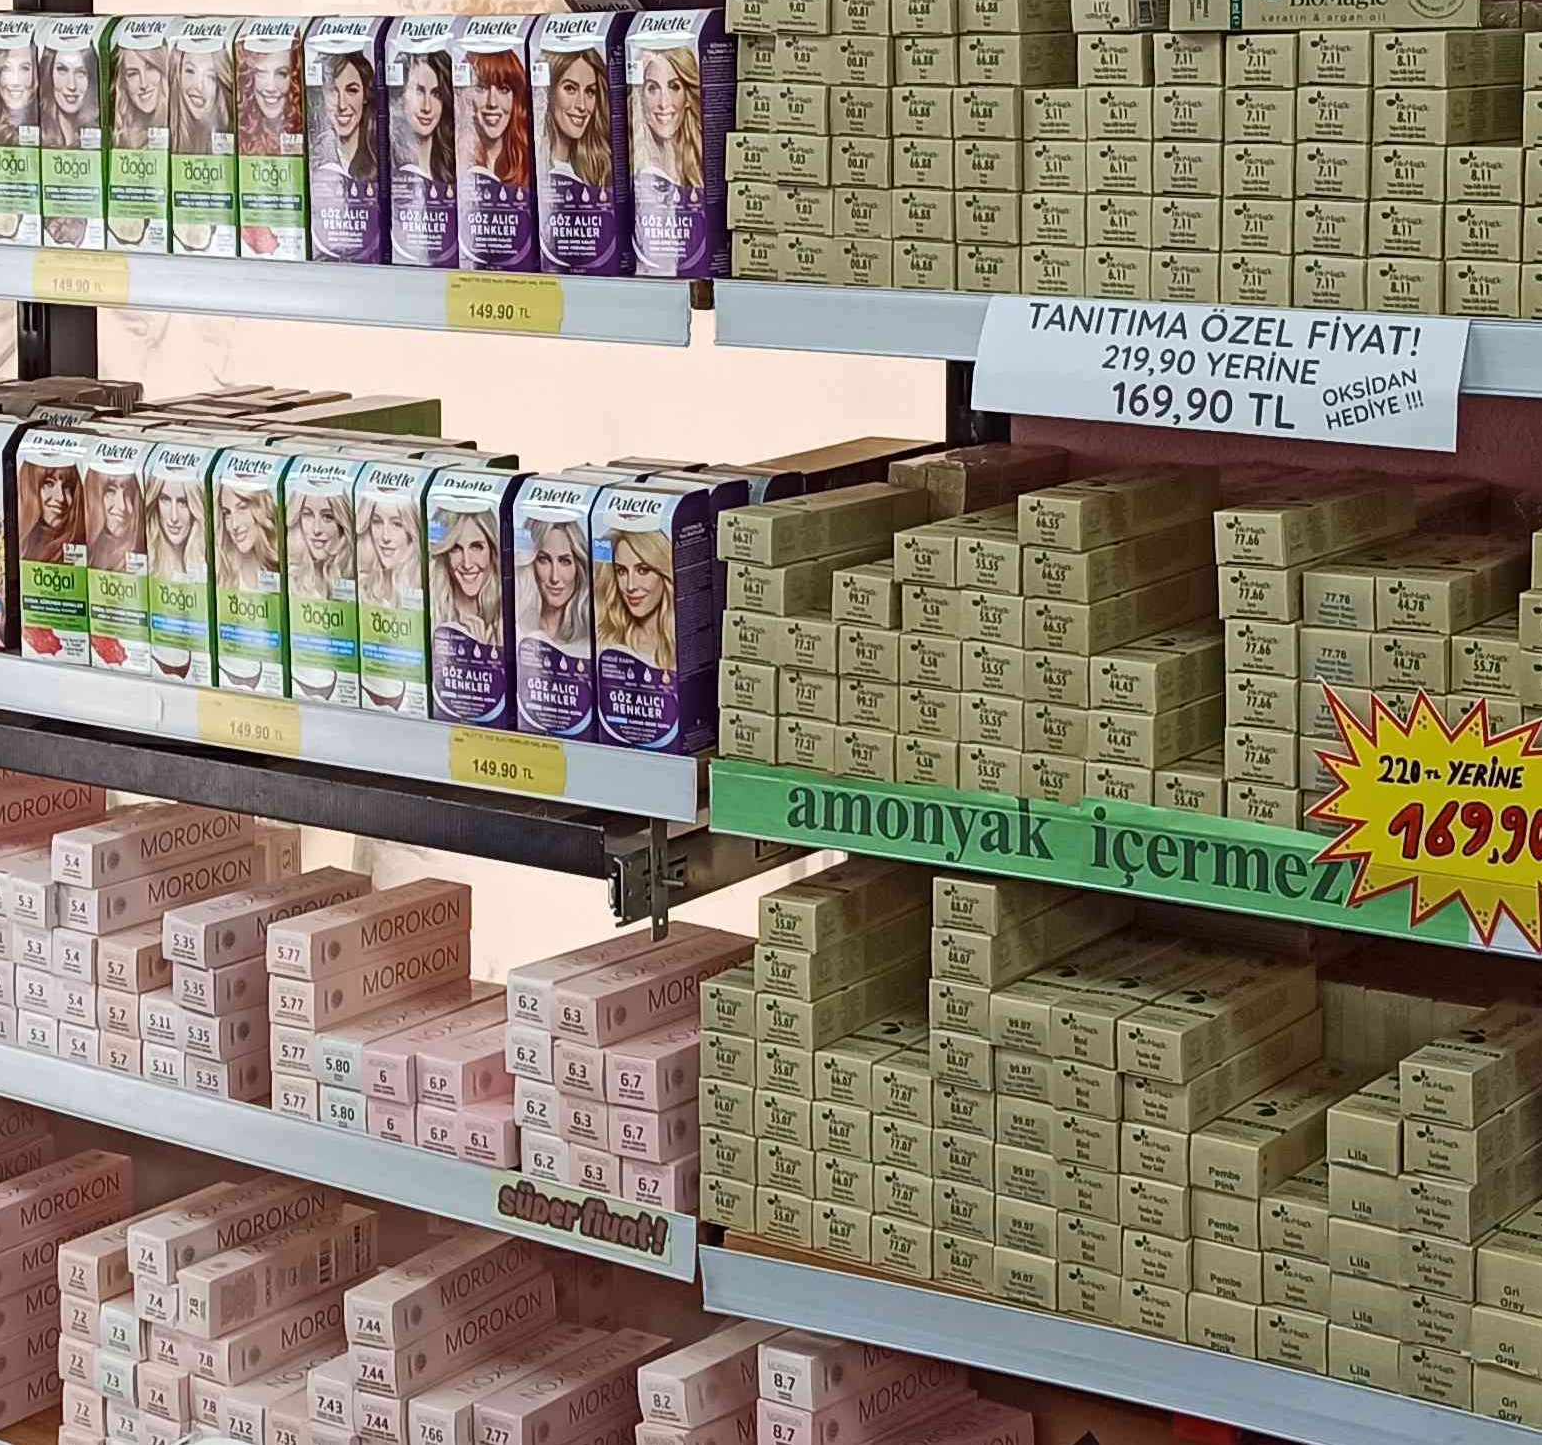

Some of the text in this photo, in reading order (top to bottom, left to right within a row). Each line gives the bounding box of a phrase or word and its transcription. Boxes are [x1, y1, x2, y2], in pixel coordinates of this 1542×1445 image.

[1028, 302, 1422, 357] TANITIMA ÖZEL FİYAT!
[1101, 345, 1320, 386] 219,90 YERİNE
[1112, 382, 1295, 430] 169,90 TL
[1322, 368, 1418, 409] OKSİDAN
[1325, 395, 1402, 432] HEDİYE
[607, 495, 662, 517] Palette
[34, 572, 75, 593] doğal
[472, 758, 518, 779] 149.90
[1377, 755, 1420, 784] 220
[1446, 756, 1525, 790] YERİNE
[140, 815, 242, 861] MOROKON
[787, 779, 1361, 906] amonyak içermez
[147, 857, 251, 904] MOROKON
[360, 899, 462, 948] MOROKON
[277, 946, 301, 963] 5.77
[519, 995, 538, 1012] 6.2
[563, 1006, 581, 1024] 6.3
[1348, 1149, 1368, 1162] Lila
[1503, 1285, 1520, 1297] Gri
